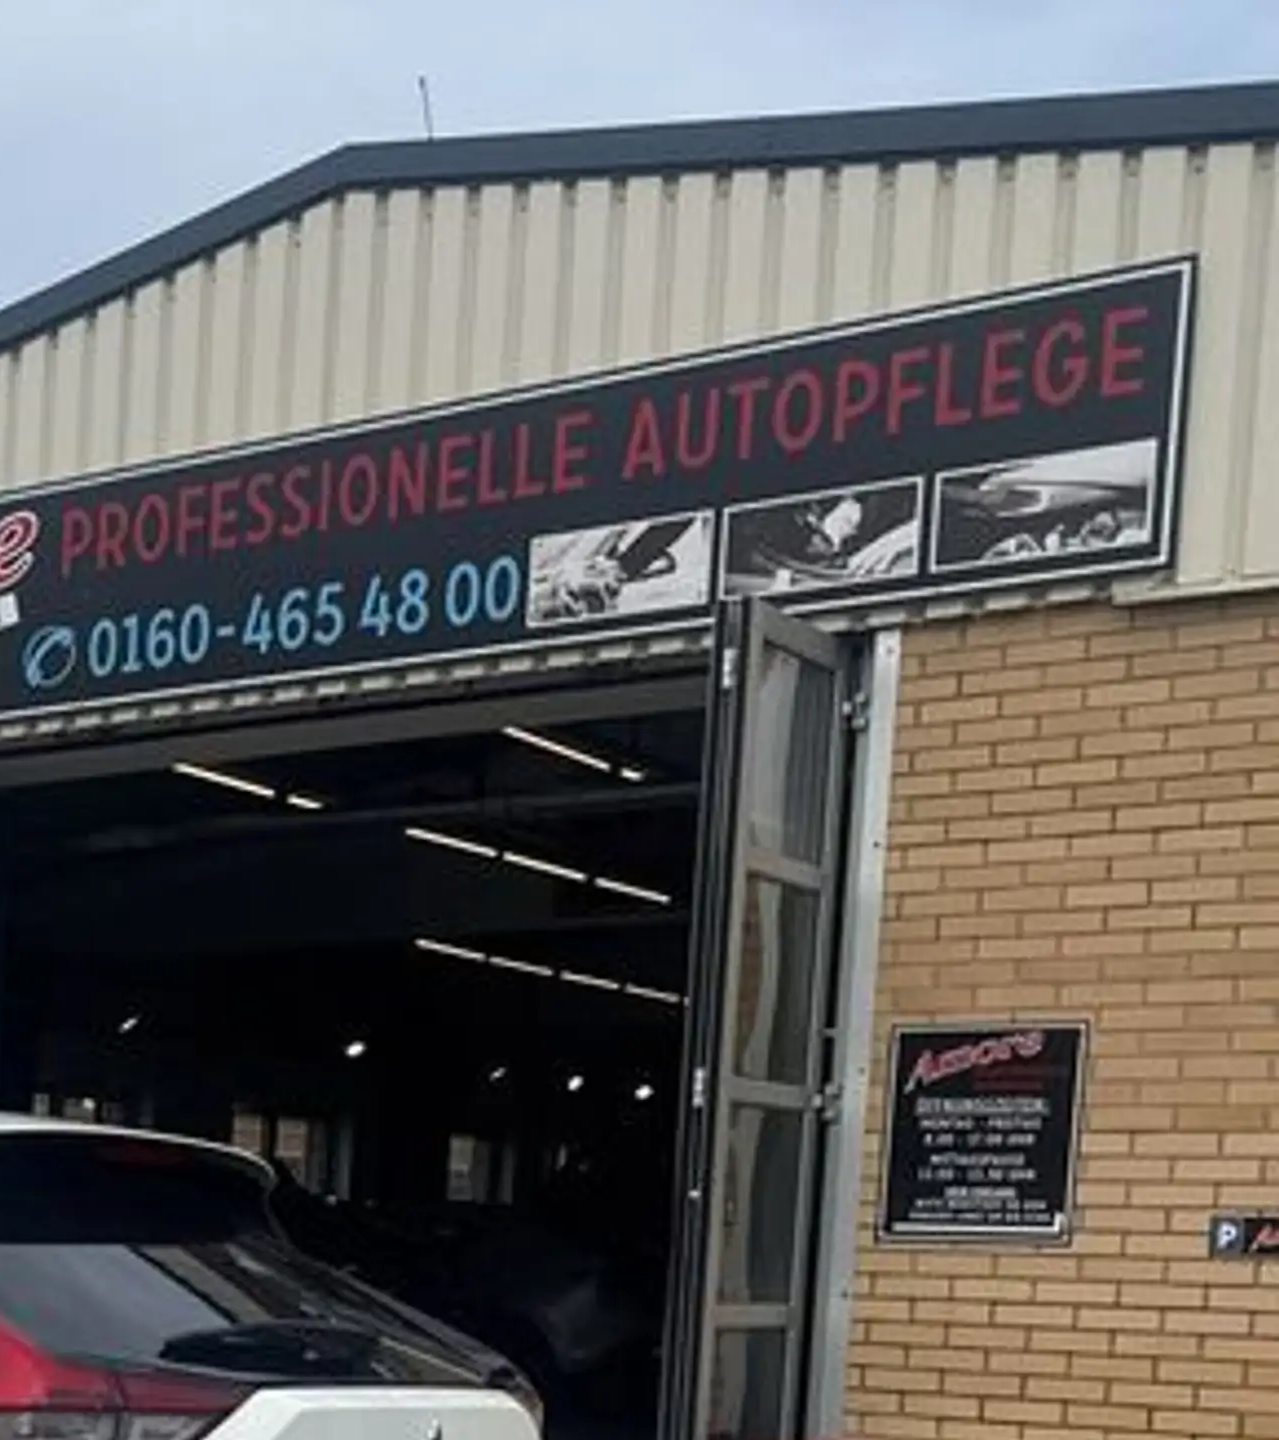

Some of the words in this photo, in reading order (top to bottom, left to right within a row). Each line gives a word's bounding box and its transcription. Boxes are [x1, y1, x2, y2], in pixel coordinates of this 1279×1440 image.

[60, 410, 595, 579] PROFESSIONELLE
[622, 307, 1150, 480] AUTOPFLEGE
[88, 583, 344, 678] 0160-465
[359, 568, 431, 637] 48
[444, 556, 520, 627] 00
